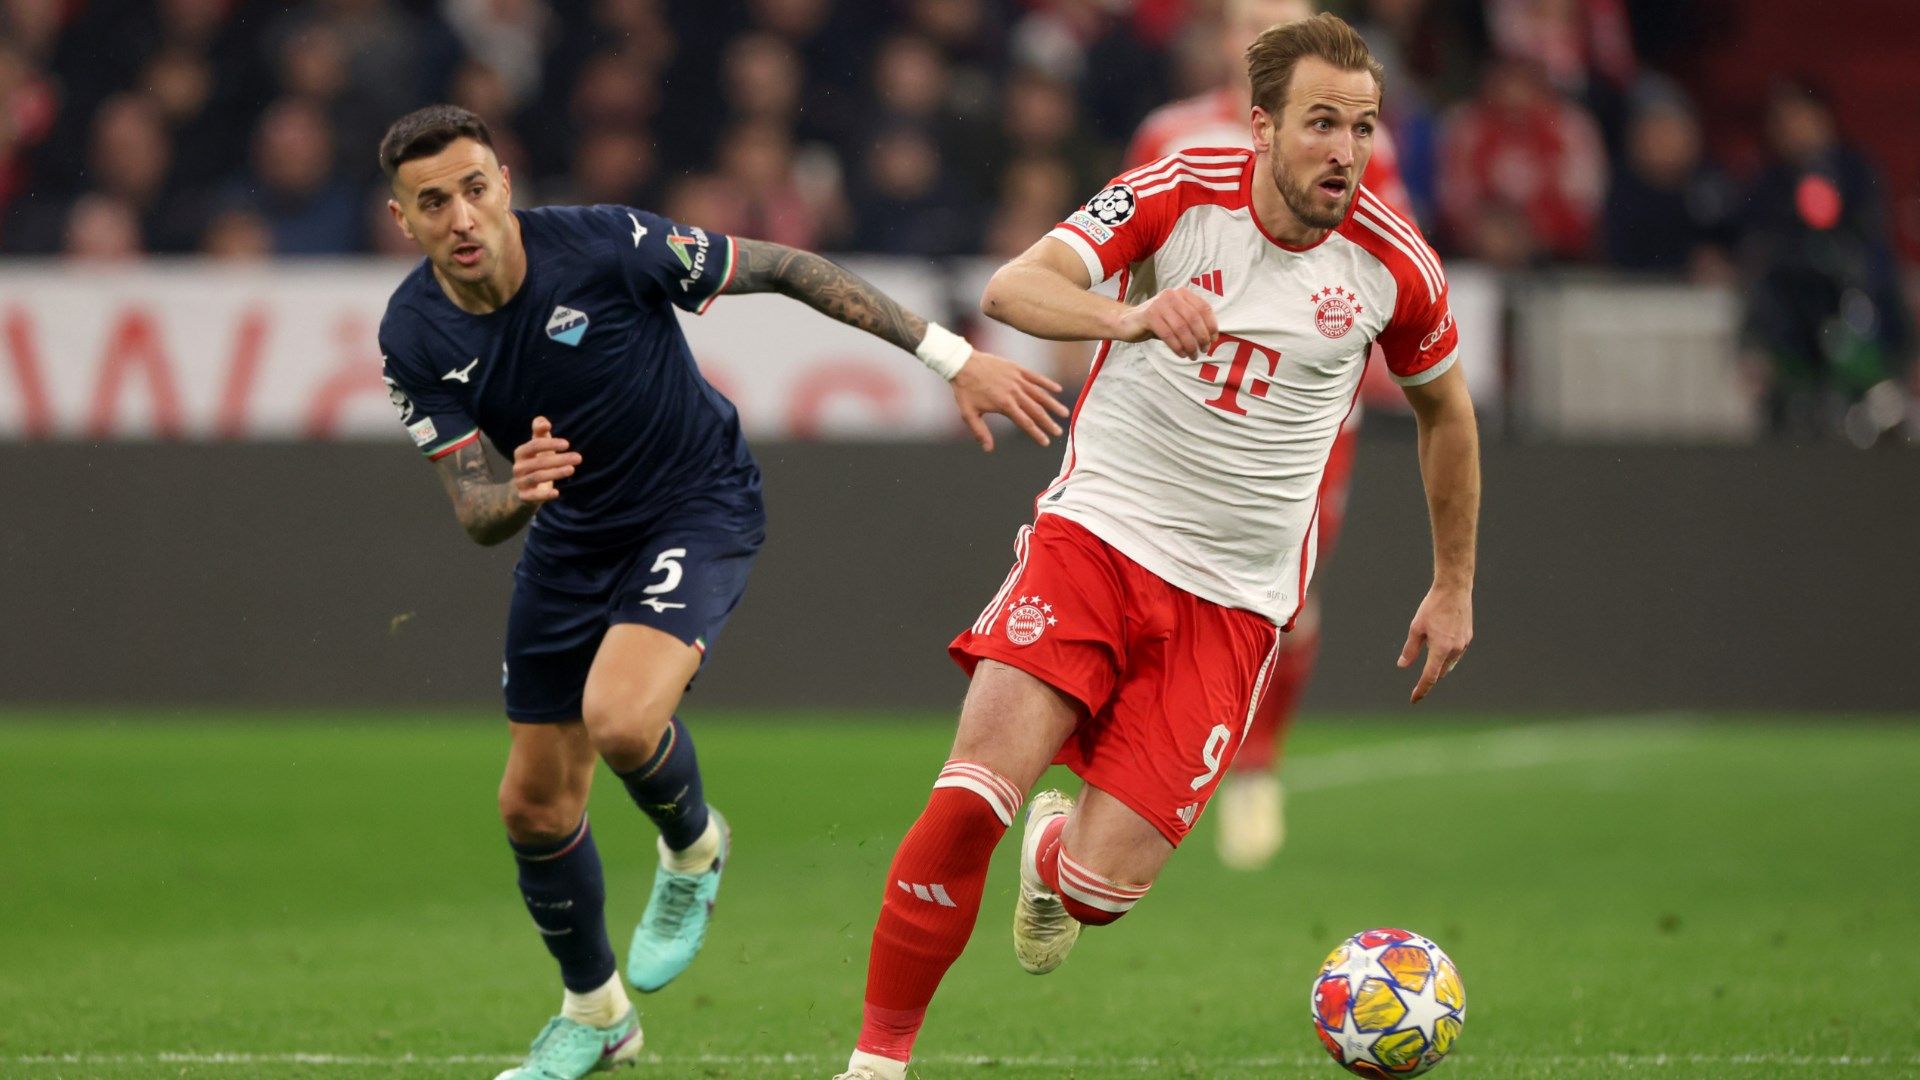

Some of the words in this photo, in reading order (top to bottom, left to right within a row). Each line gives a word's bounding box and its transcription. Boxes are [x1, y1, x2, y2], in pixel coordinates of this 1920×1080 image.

[1330, 300, 1352, 319] BAYERN
[1203, 332, 1281, 416] T
[642, 547, 687, 594] 5
[1190, 724, 1231, 791] 9
